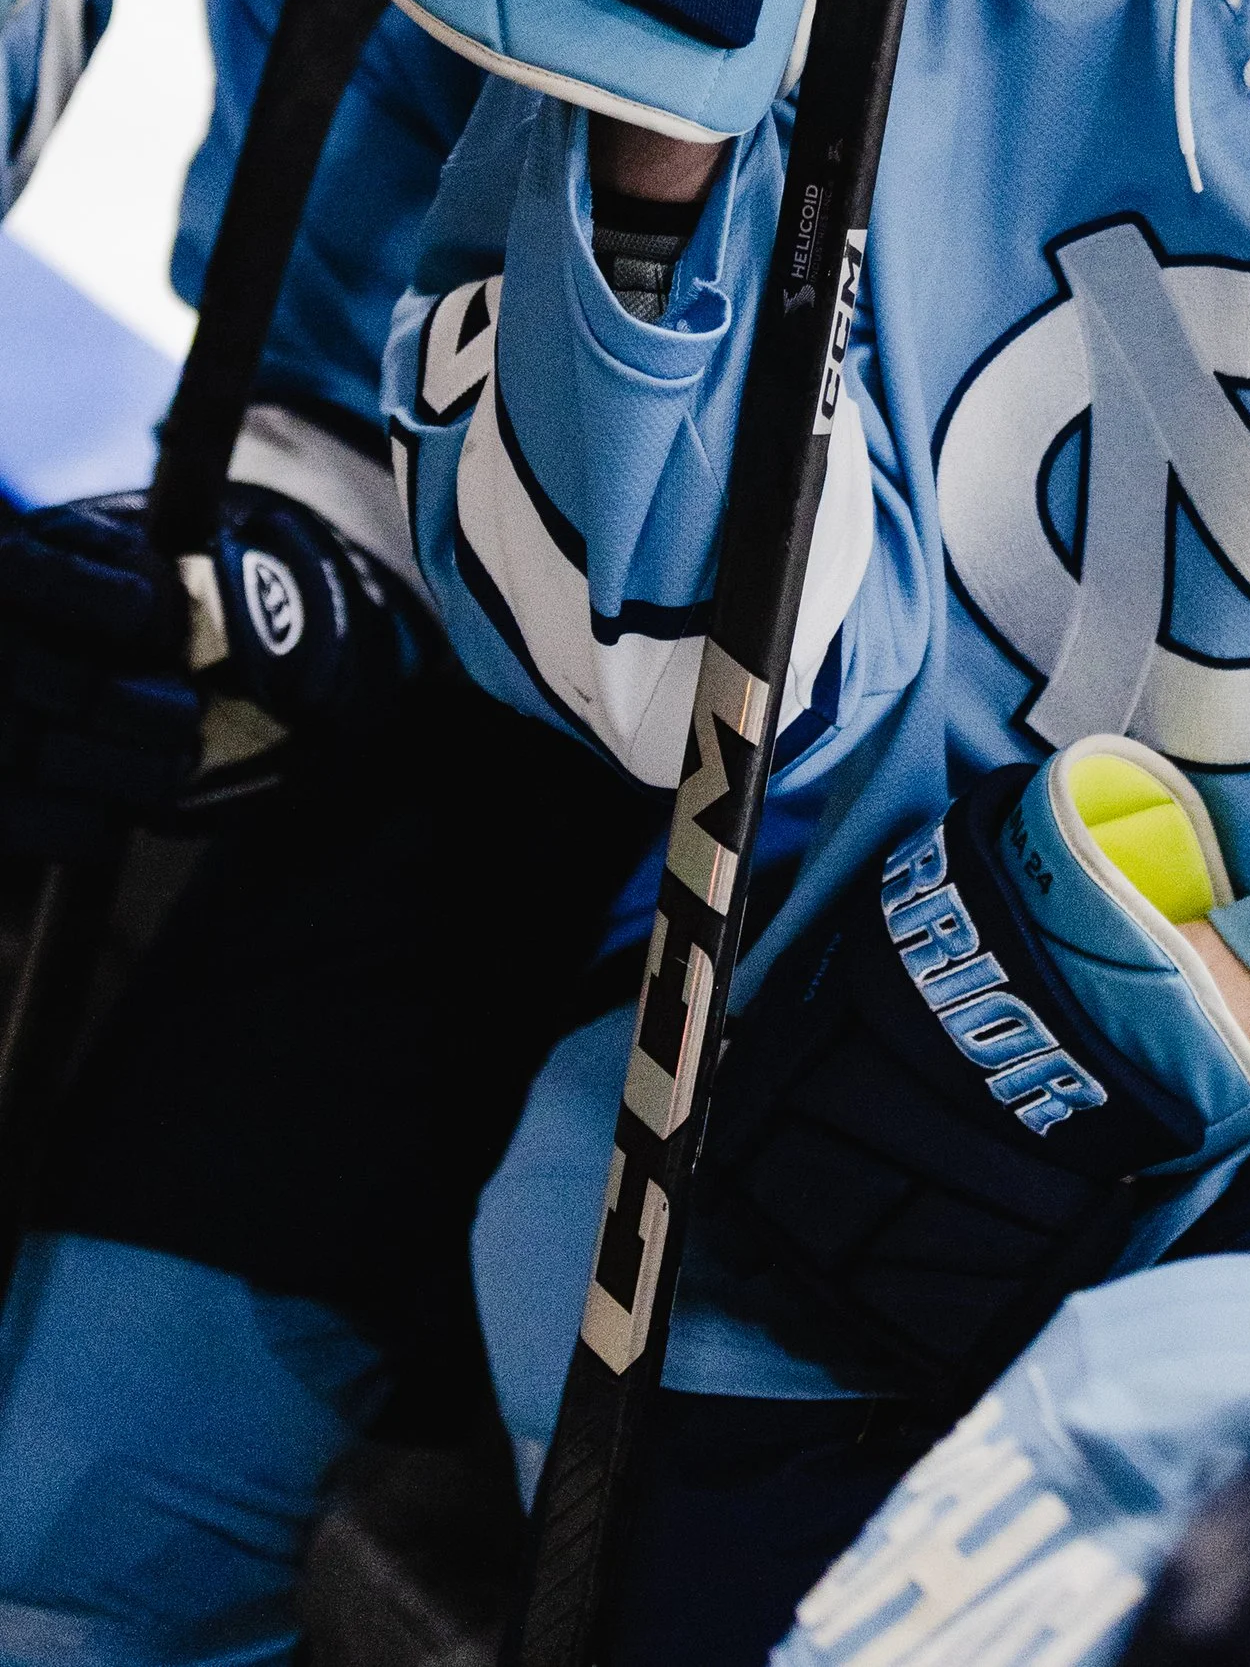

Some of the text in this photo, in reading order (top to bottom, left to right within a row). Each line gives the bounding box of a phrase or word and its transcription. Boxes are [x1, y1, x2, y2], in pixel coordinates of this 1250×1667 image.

[790, 184, 819, 279] HELICOID
[820, 237, 863, 421] CCM
[580, 640, 770, 1375] CCM
